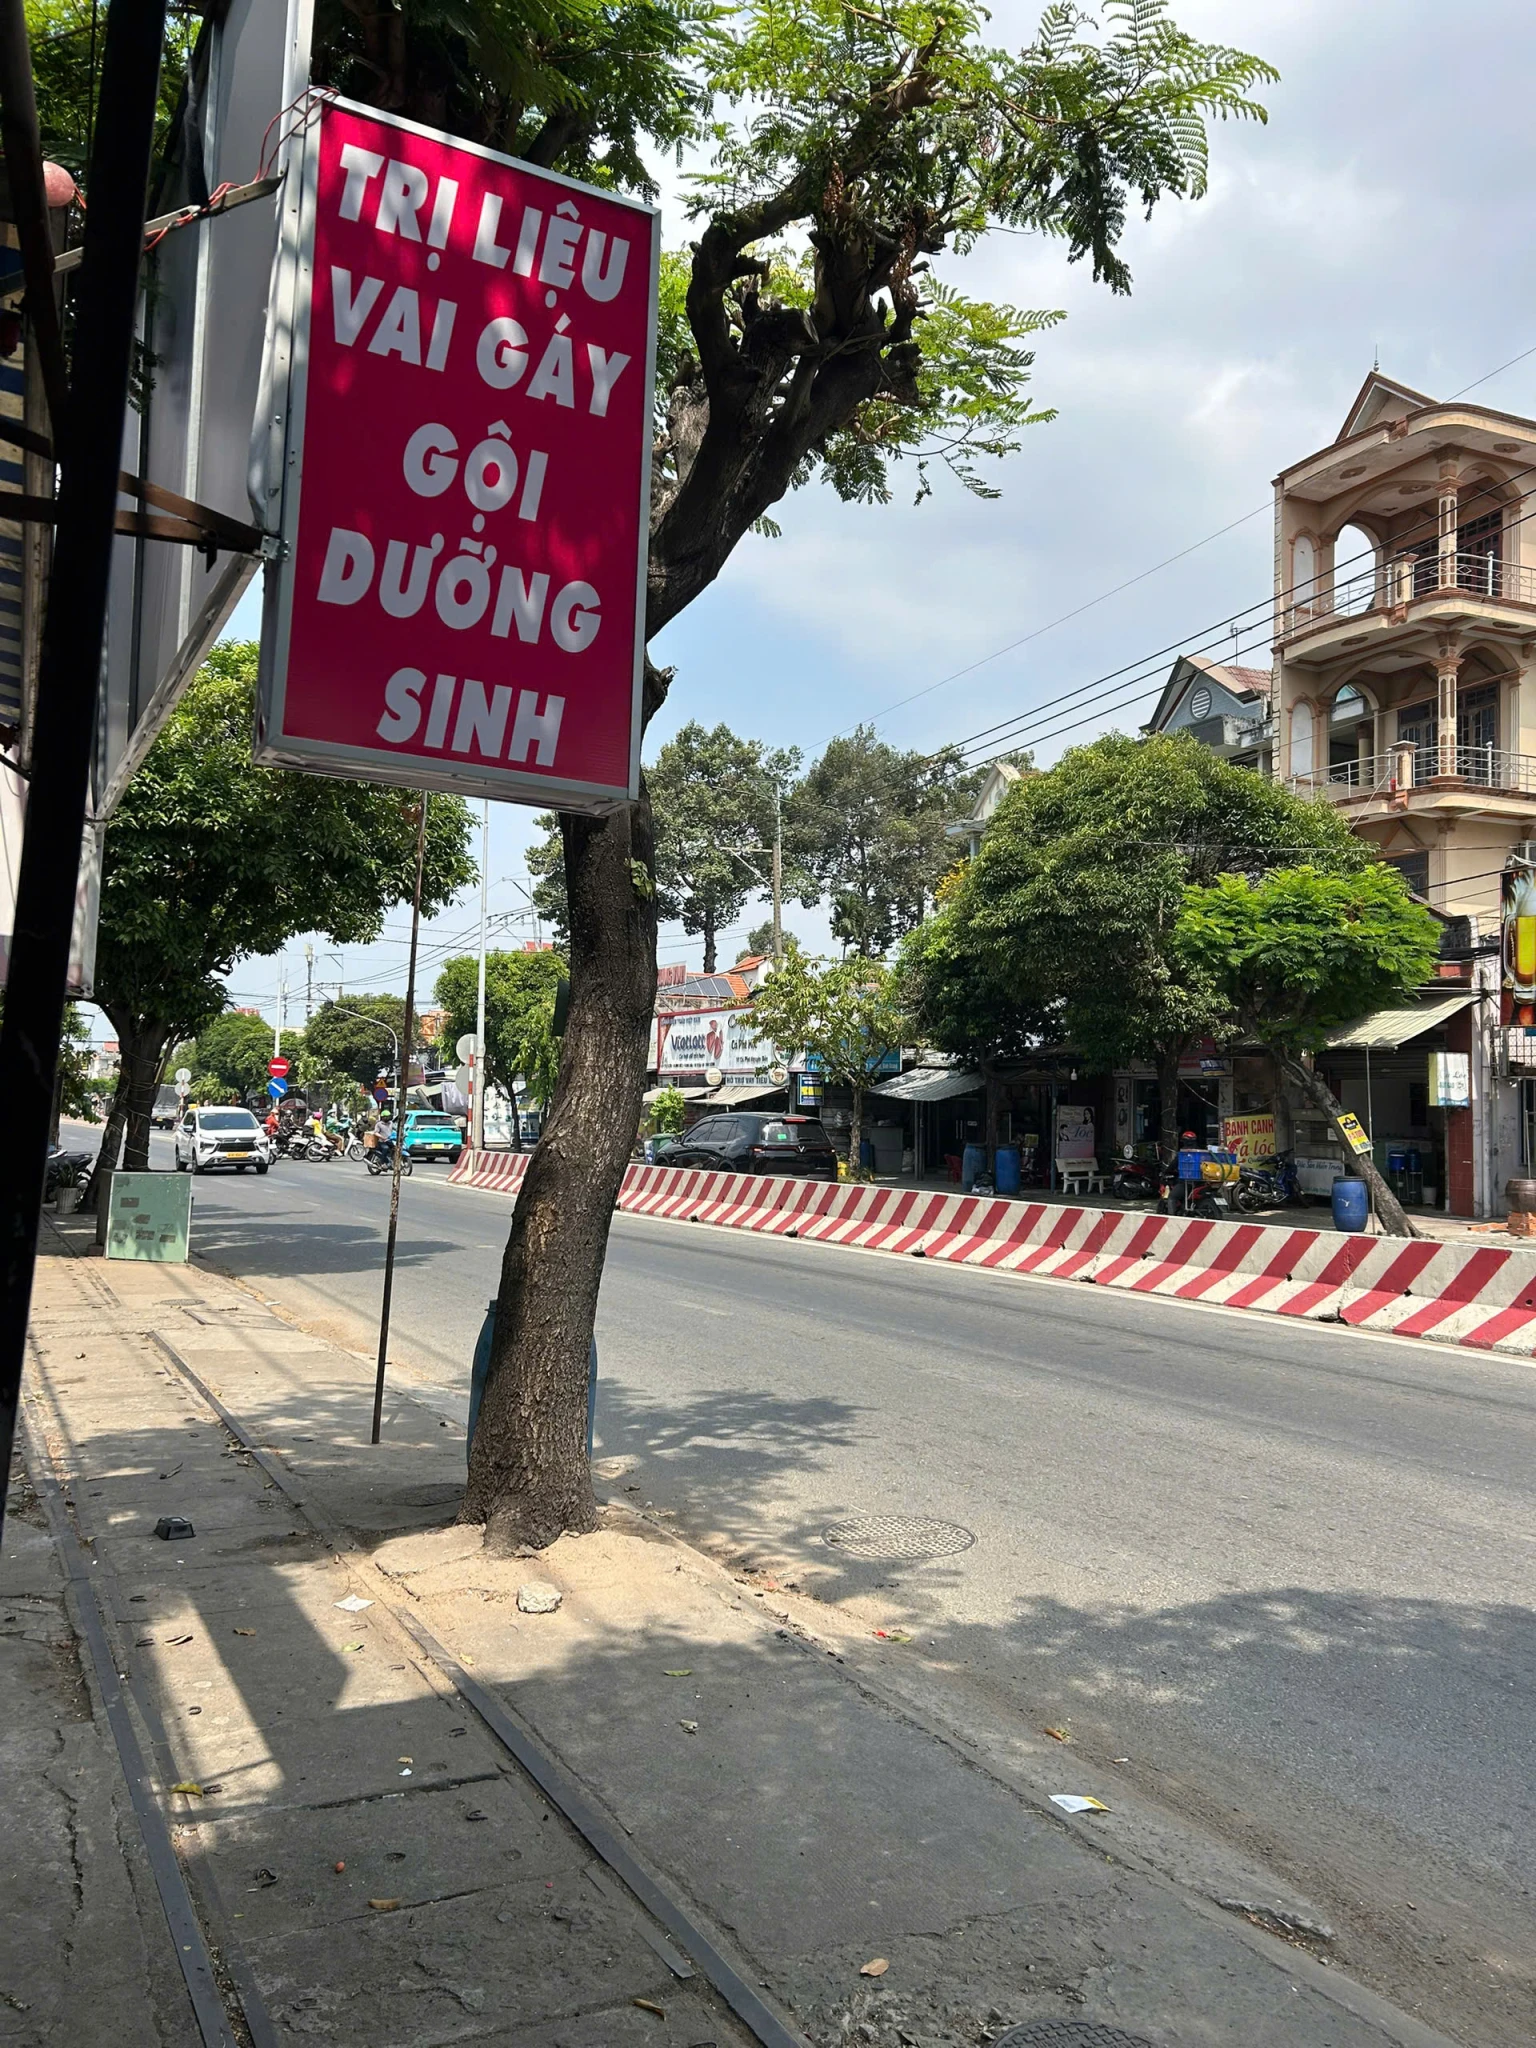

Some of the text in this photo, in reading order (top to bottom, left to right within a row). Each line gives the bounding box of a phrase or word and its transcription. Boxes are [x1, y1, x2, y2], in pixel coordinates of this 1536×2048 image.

[338, 142, 631, 309] TRỊ LIỆU
[331, 265, 632, 418] VAI GÁY
[402, 419, 549, 533] GỘI
[316, 526, 602, 653] DƯỠNG
[376, 667, 566, 768] SINH
[1251, 1119, 1274, 1135] CANH
[1253, 1139, 1275, 1156] lóc
